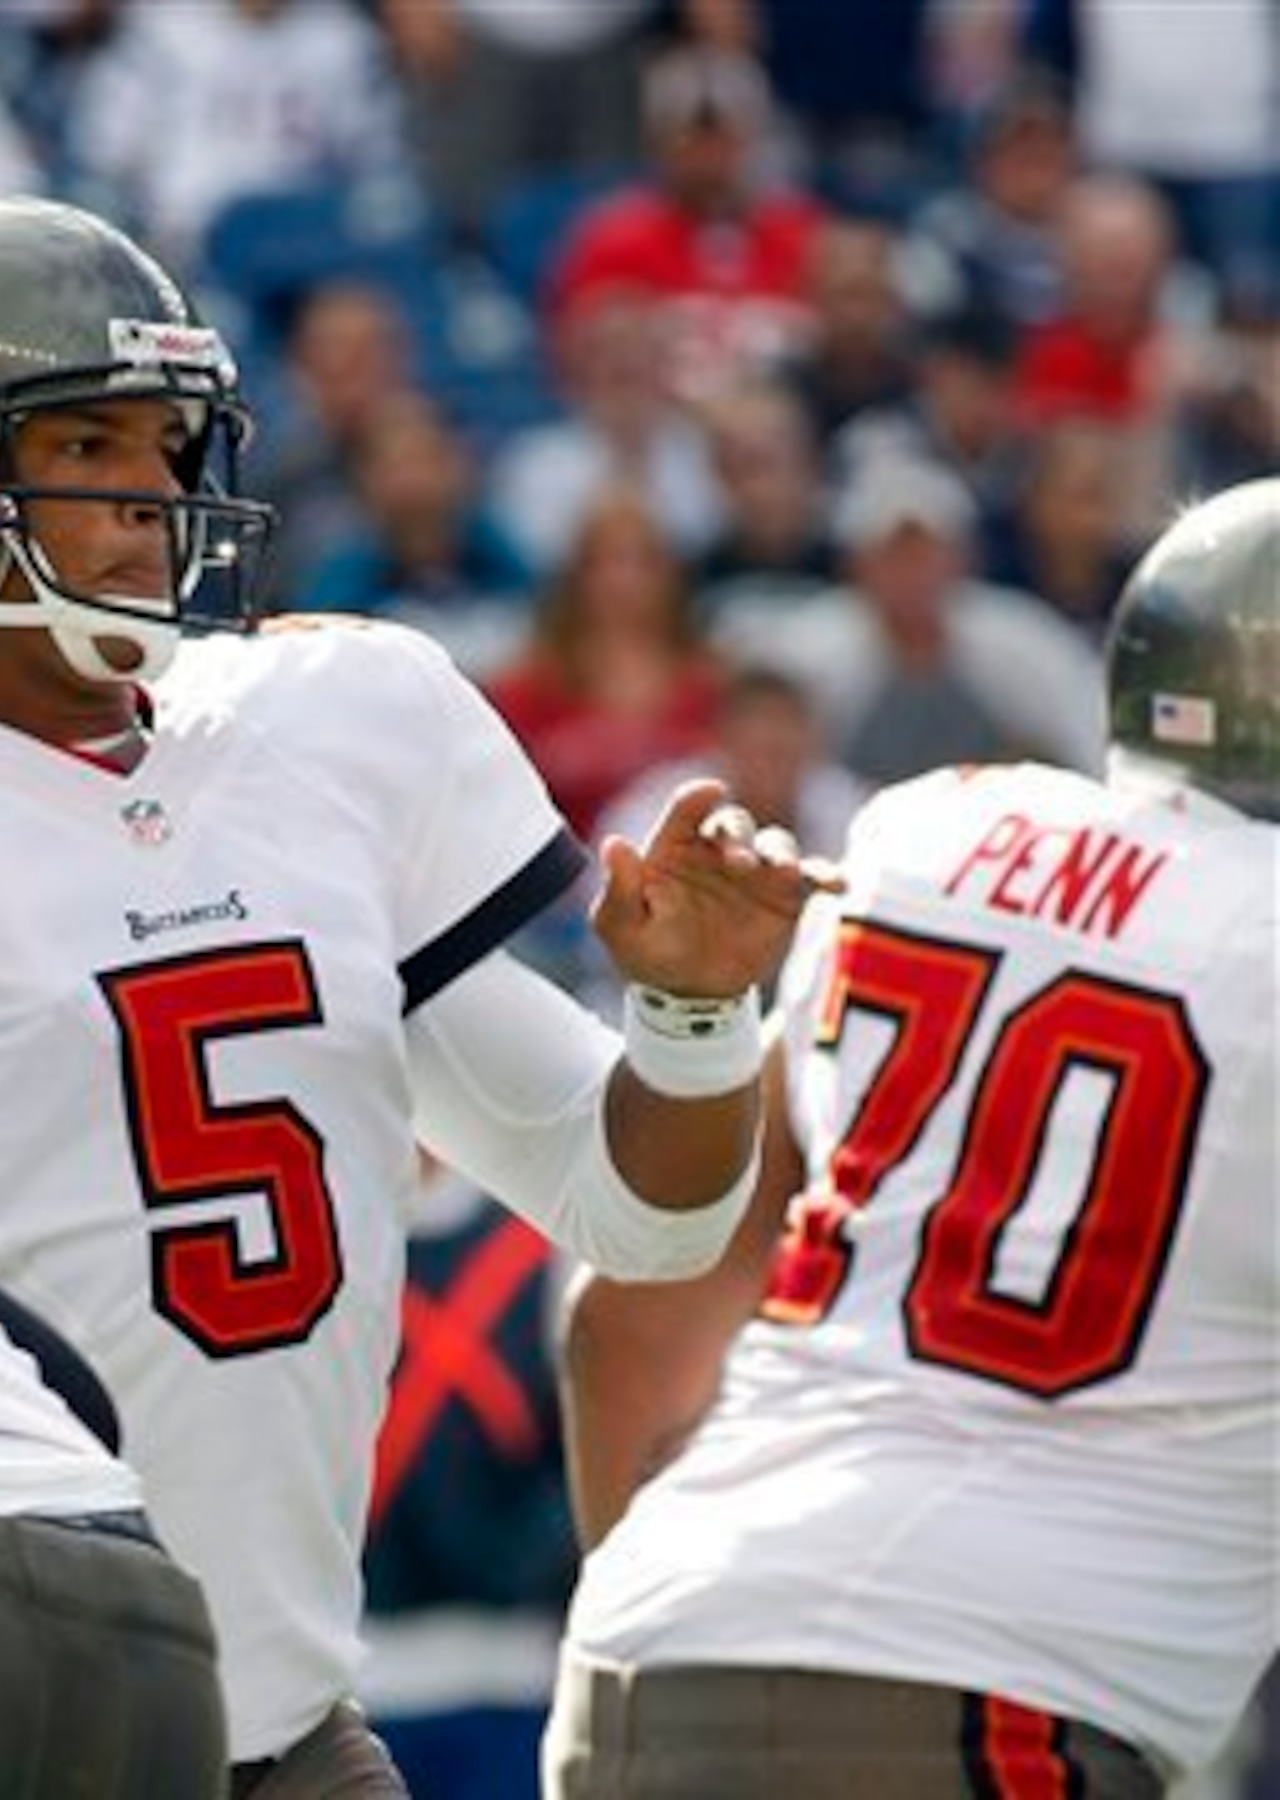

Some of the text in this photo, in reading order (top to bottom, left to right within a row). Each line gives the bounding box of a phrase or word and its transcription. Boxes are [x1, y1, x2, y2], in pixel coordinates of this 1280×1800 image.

[943, 813, 1169, 939] PENN
[92, 936, 345, 1361] 5
[760, 914, 1214, 1401] 70
